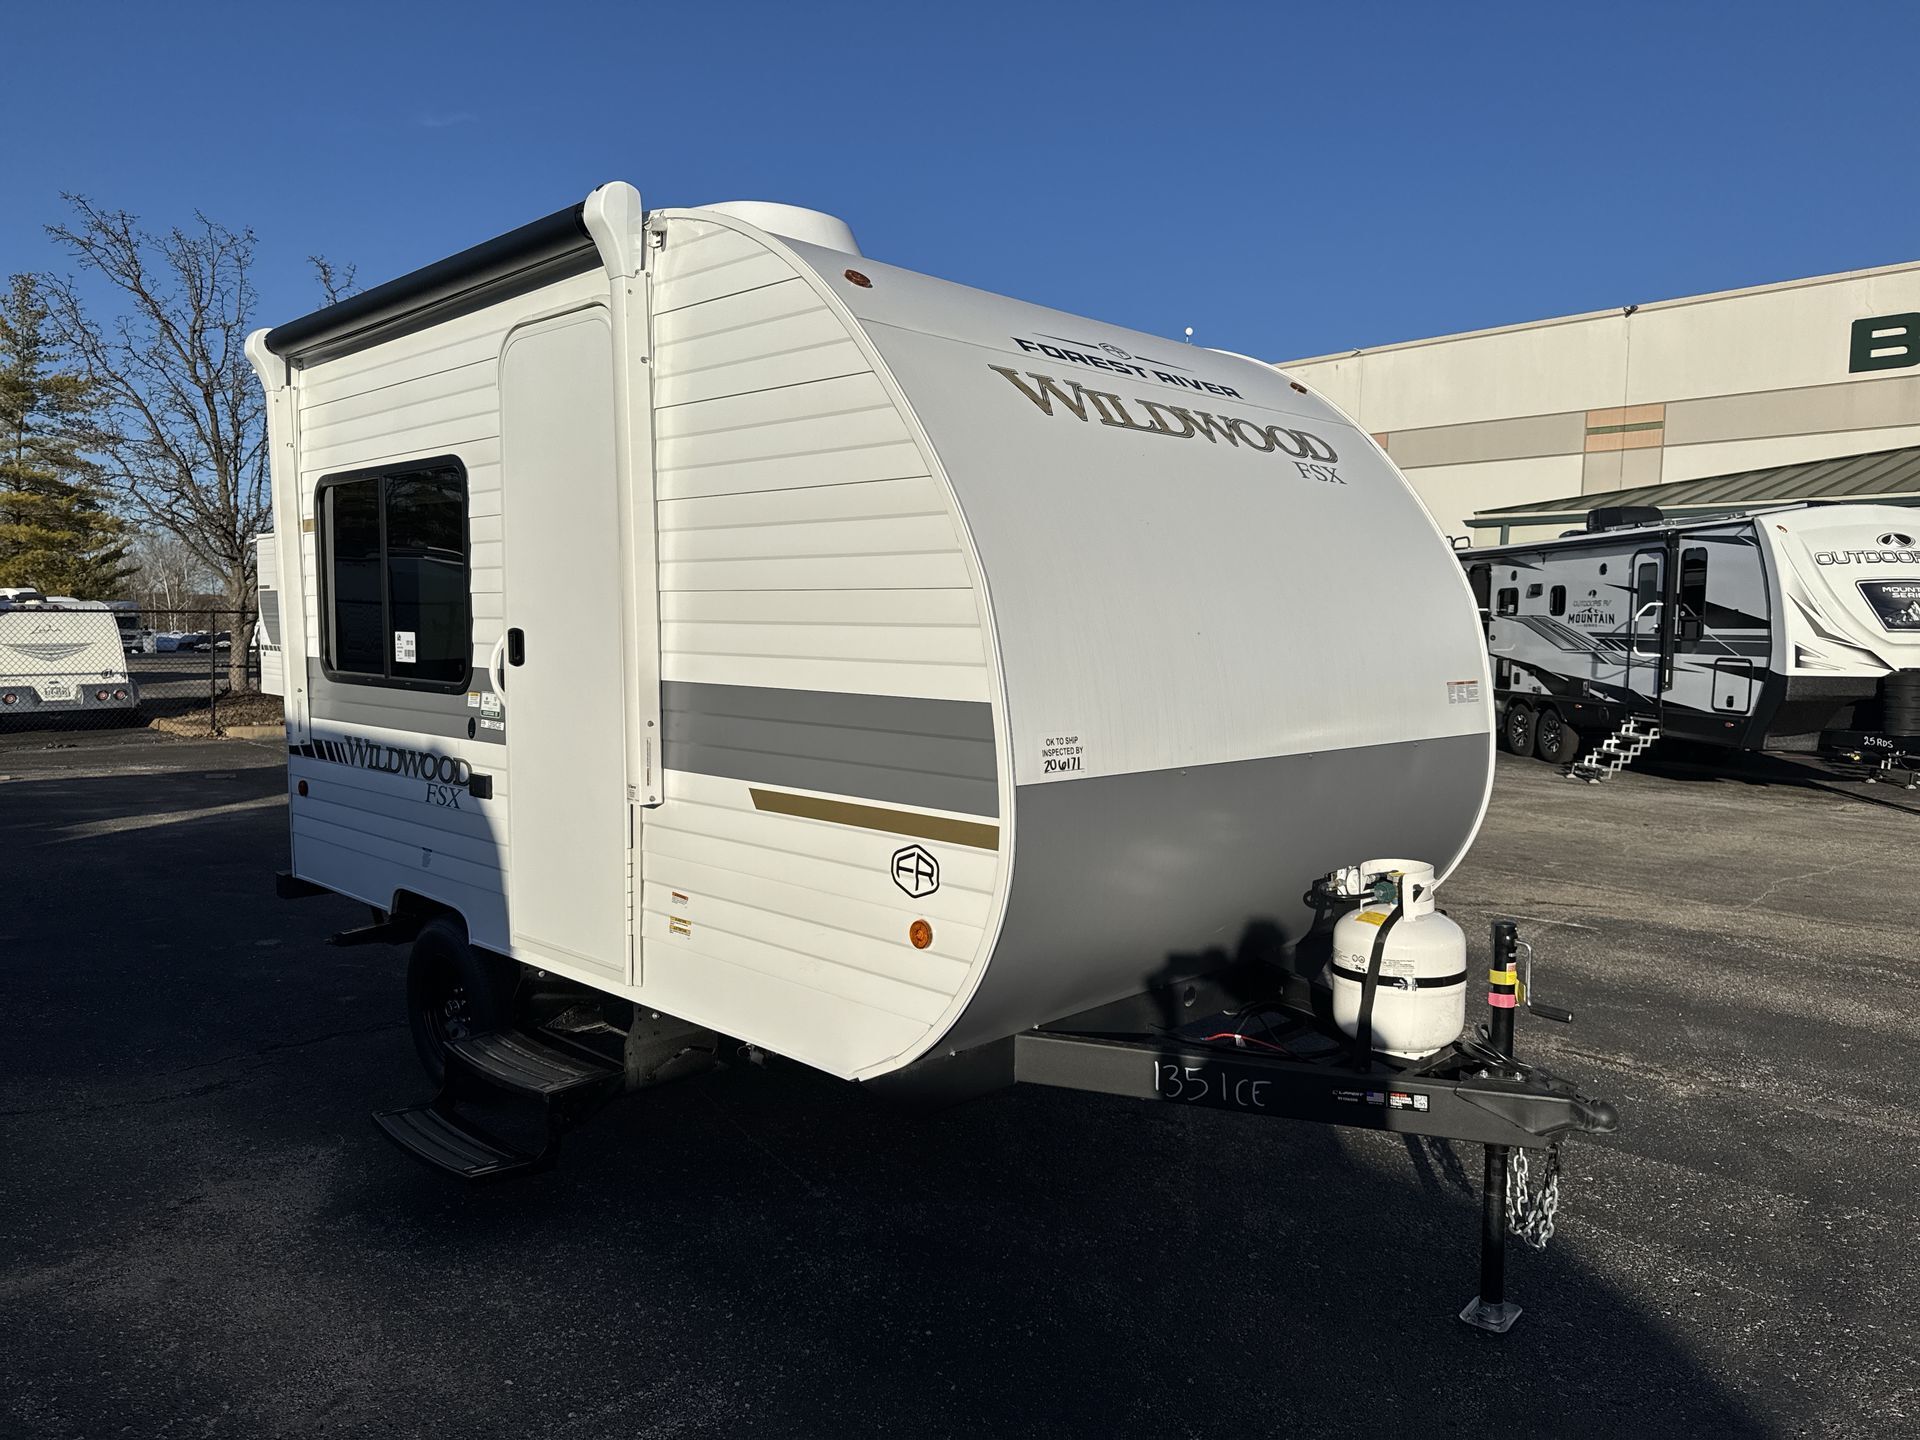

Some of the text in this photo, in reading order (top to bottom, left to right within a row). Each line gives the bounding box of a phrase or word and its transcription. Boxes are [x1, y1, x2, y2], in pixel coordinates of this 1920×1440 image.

[1848, 312, 1920, 374] B
[1010, 336, 1245, 400] FOREST RIVER
[987, 363, 1338, 464] WILDWOOD
[1291, 460, 1348, 485] FSX
[1567, 613, 1615, 625] MOUNTAIN
[1042, 746, 1083, 757] INSPECTED BY
[1046, 736, 1078, 746] OK TO SHIP
[344, 735, 473, 787] WILDWOOD
[425, 782, 464, 810] FSX
